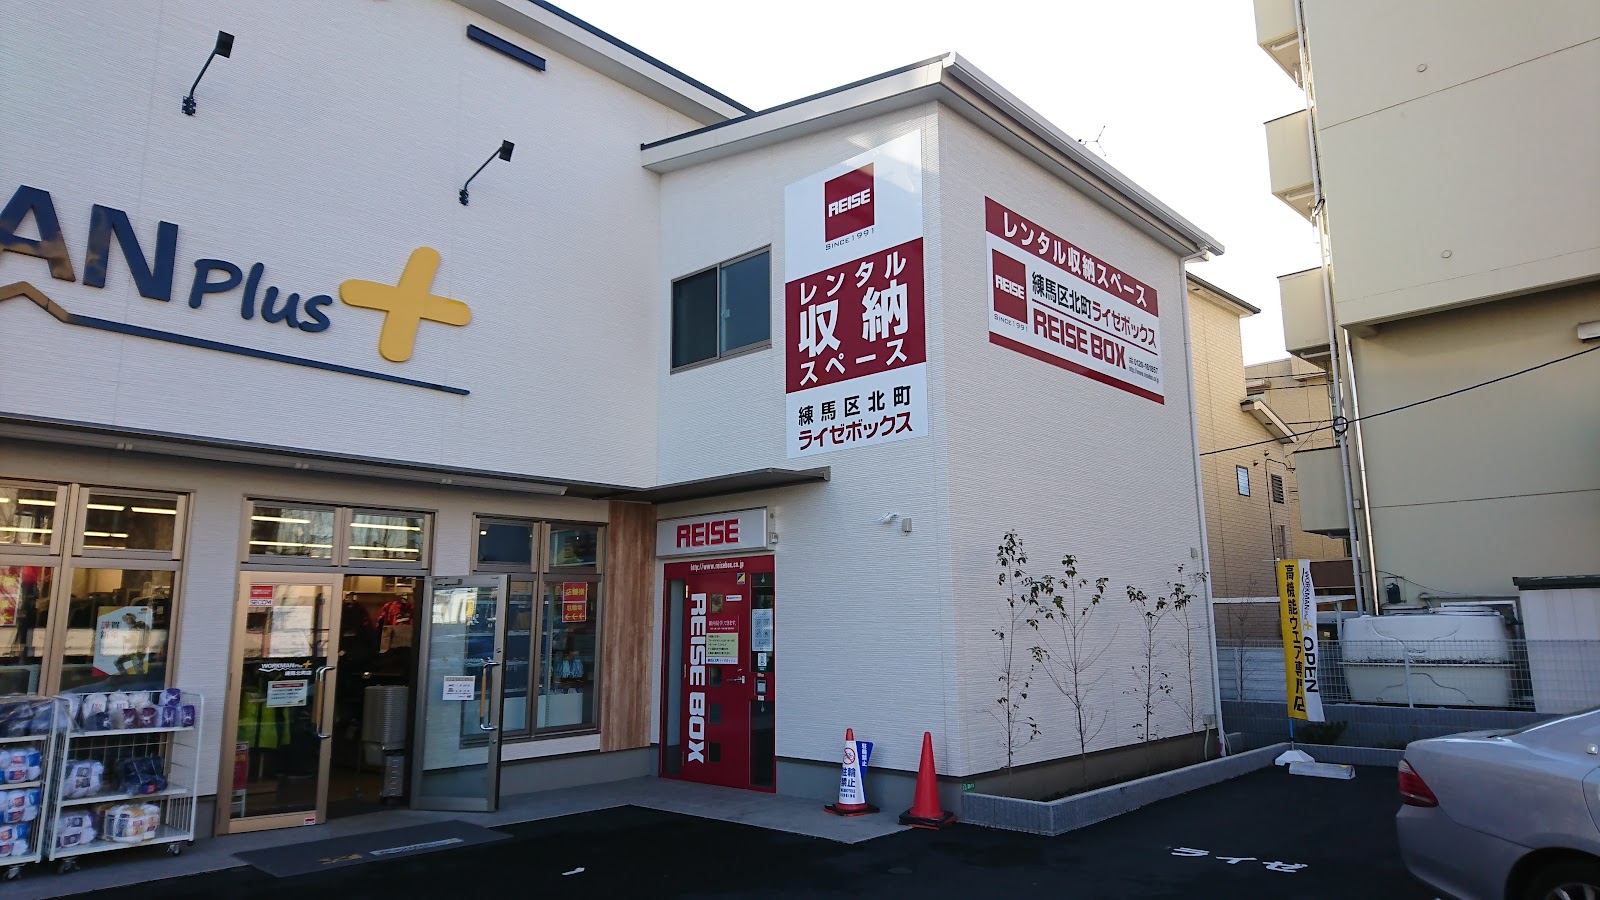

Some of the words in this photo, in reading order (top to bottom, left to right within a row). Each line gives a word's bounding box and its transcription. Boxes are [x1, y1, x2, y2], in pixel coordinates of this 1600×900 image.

[828, 188, 871, 218] REISE
[799, 250, 907, 306] レンタル
[995, 273, 1025, 300] REISE
[1003, 211, 1148, 308] レンタル収納スペース
[188, 258, 333, 333] Plus
[798, 279, 909, 358] 収納
[799, 338, 908, 387] スペース
[1033, 307, 1089, 355] REISE
[1090, 332, 1127, 370] BOX
[798, 384, 912, 427] 練馬区北町
[799, 411, 913, 451] ライゼボックス
[676, 518, 740, 548] REISE
[688, 592, 707, 687] REISE
[1303, 636, 1319, 693] OPEN
[687, 692, 706, 765] BOX
